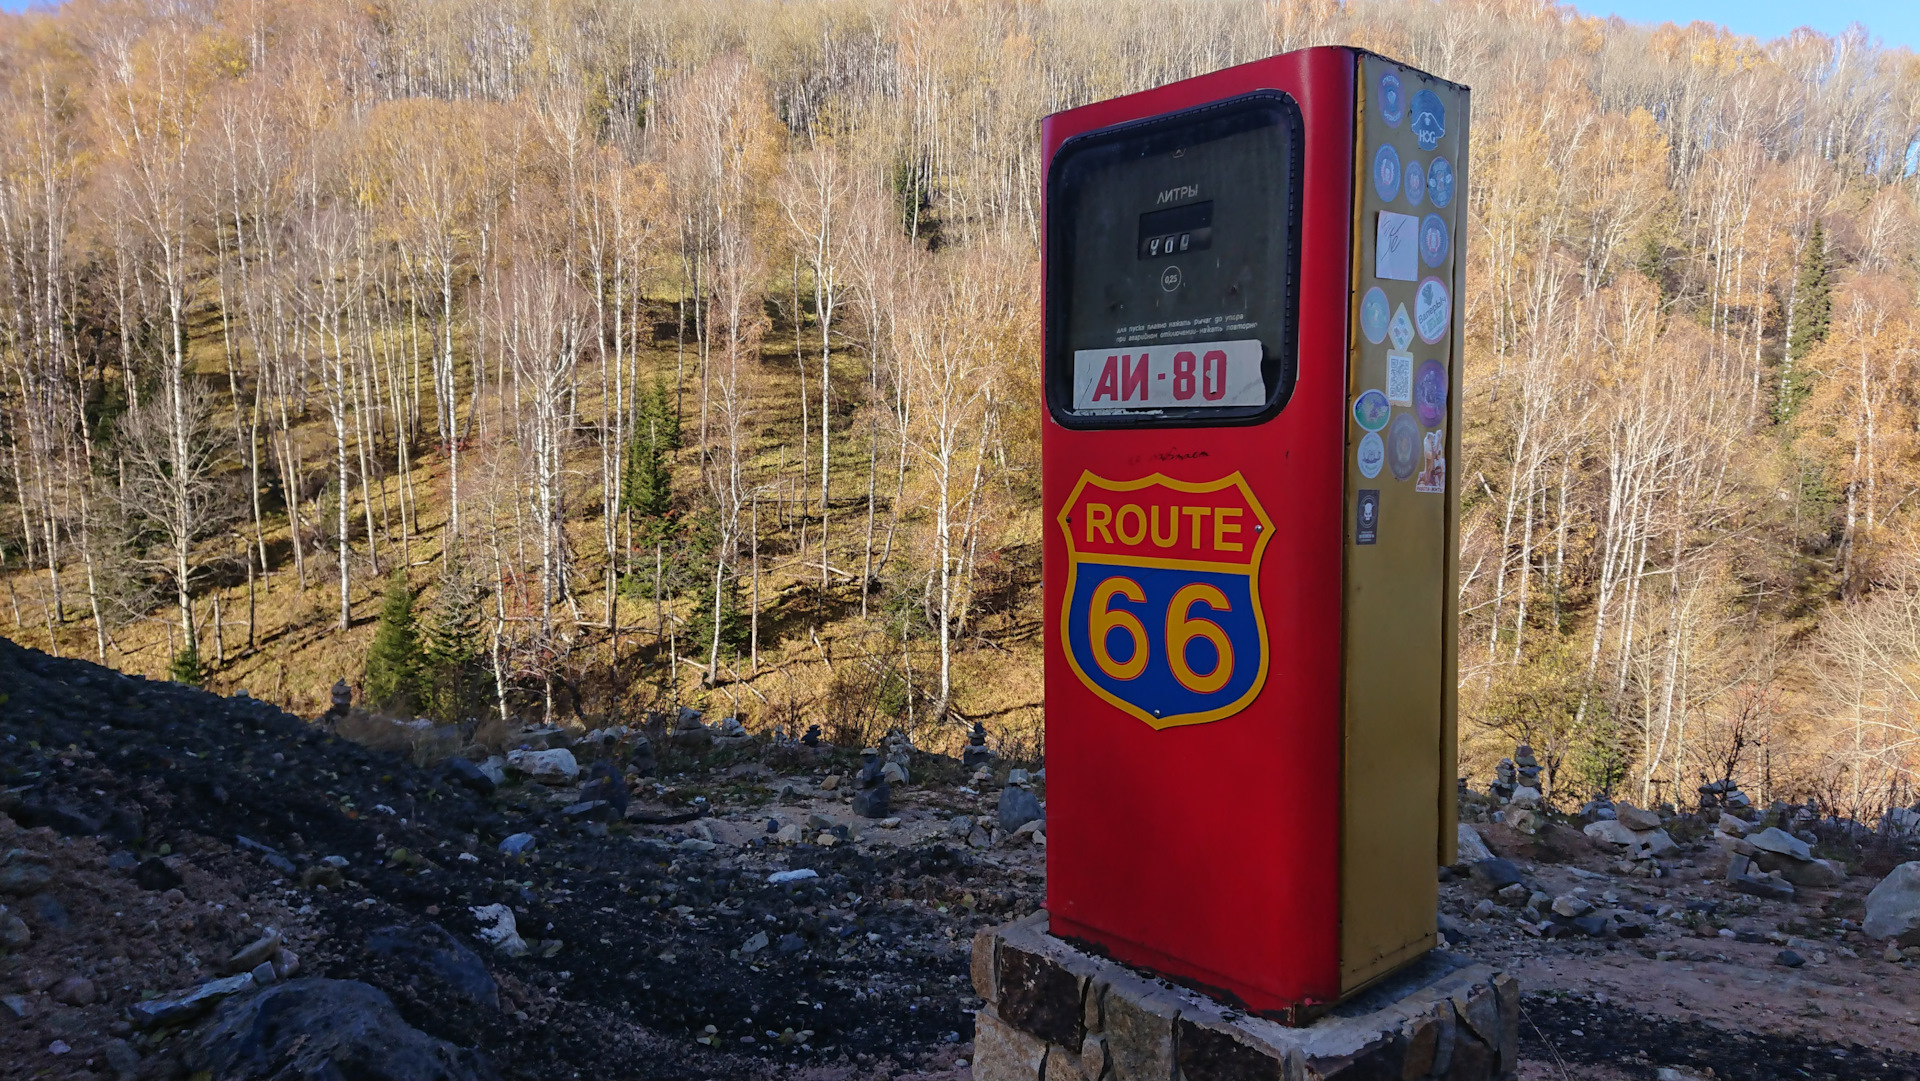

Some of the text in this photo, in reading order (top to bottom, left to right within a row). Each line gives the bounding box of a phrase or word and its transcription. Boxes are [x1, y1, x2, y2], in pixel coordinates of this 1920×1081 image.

[1419, 129, 1436, 143] HOG
[1156, 184, 1199, 204] ЛИТРЫ
[1086, 502, 1244, 552] ROUTE
[1088, 575, 1236, 694] 66
